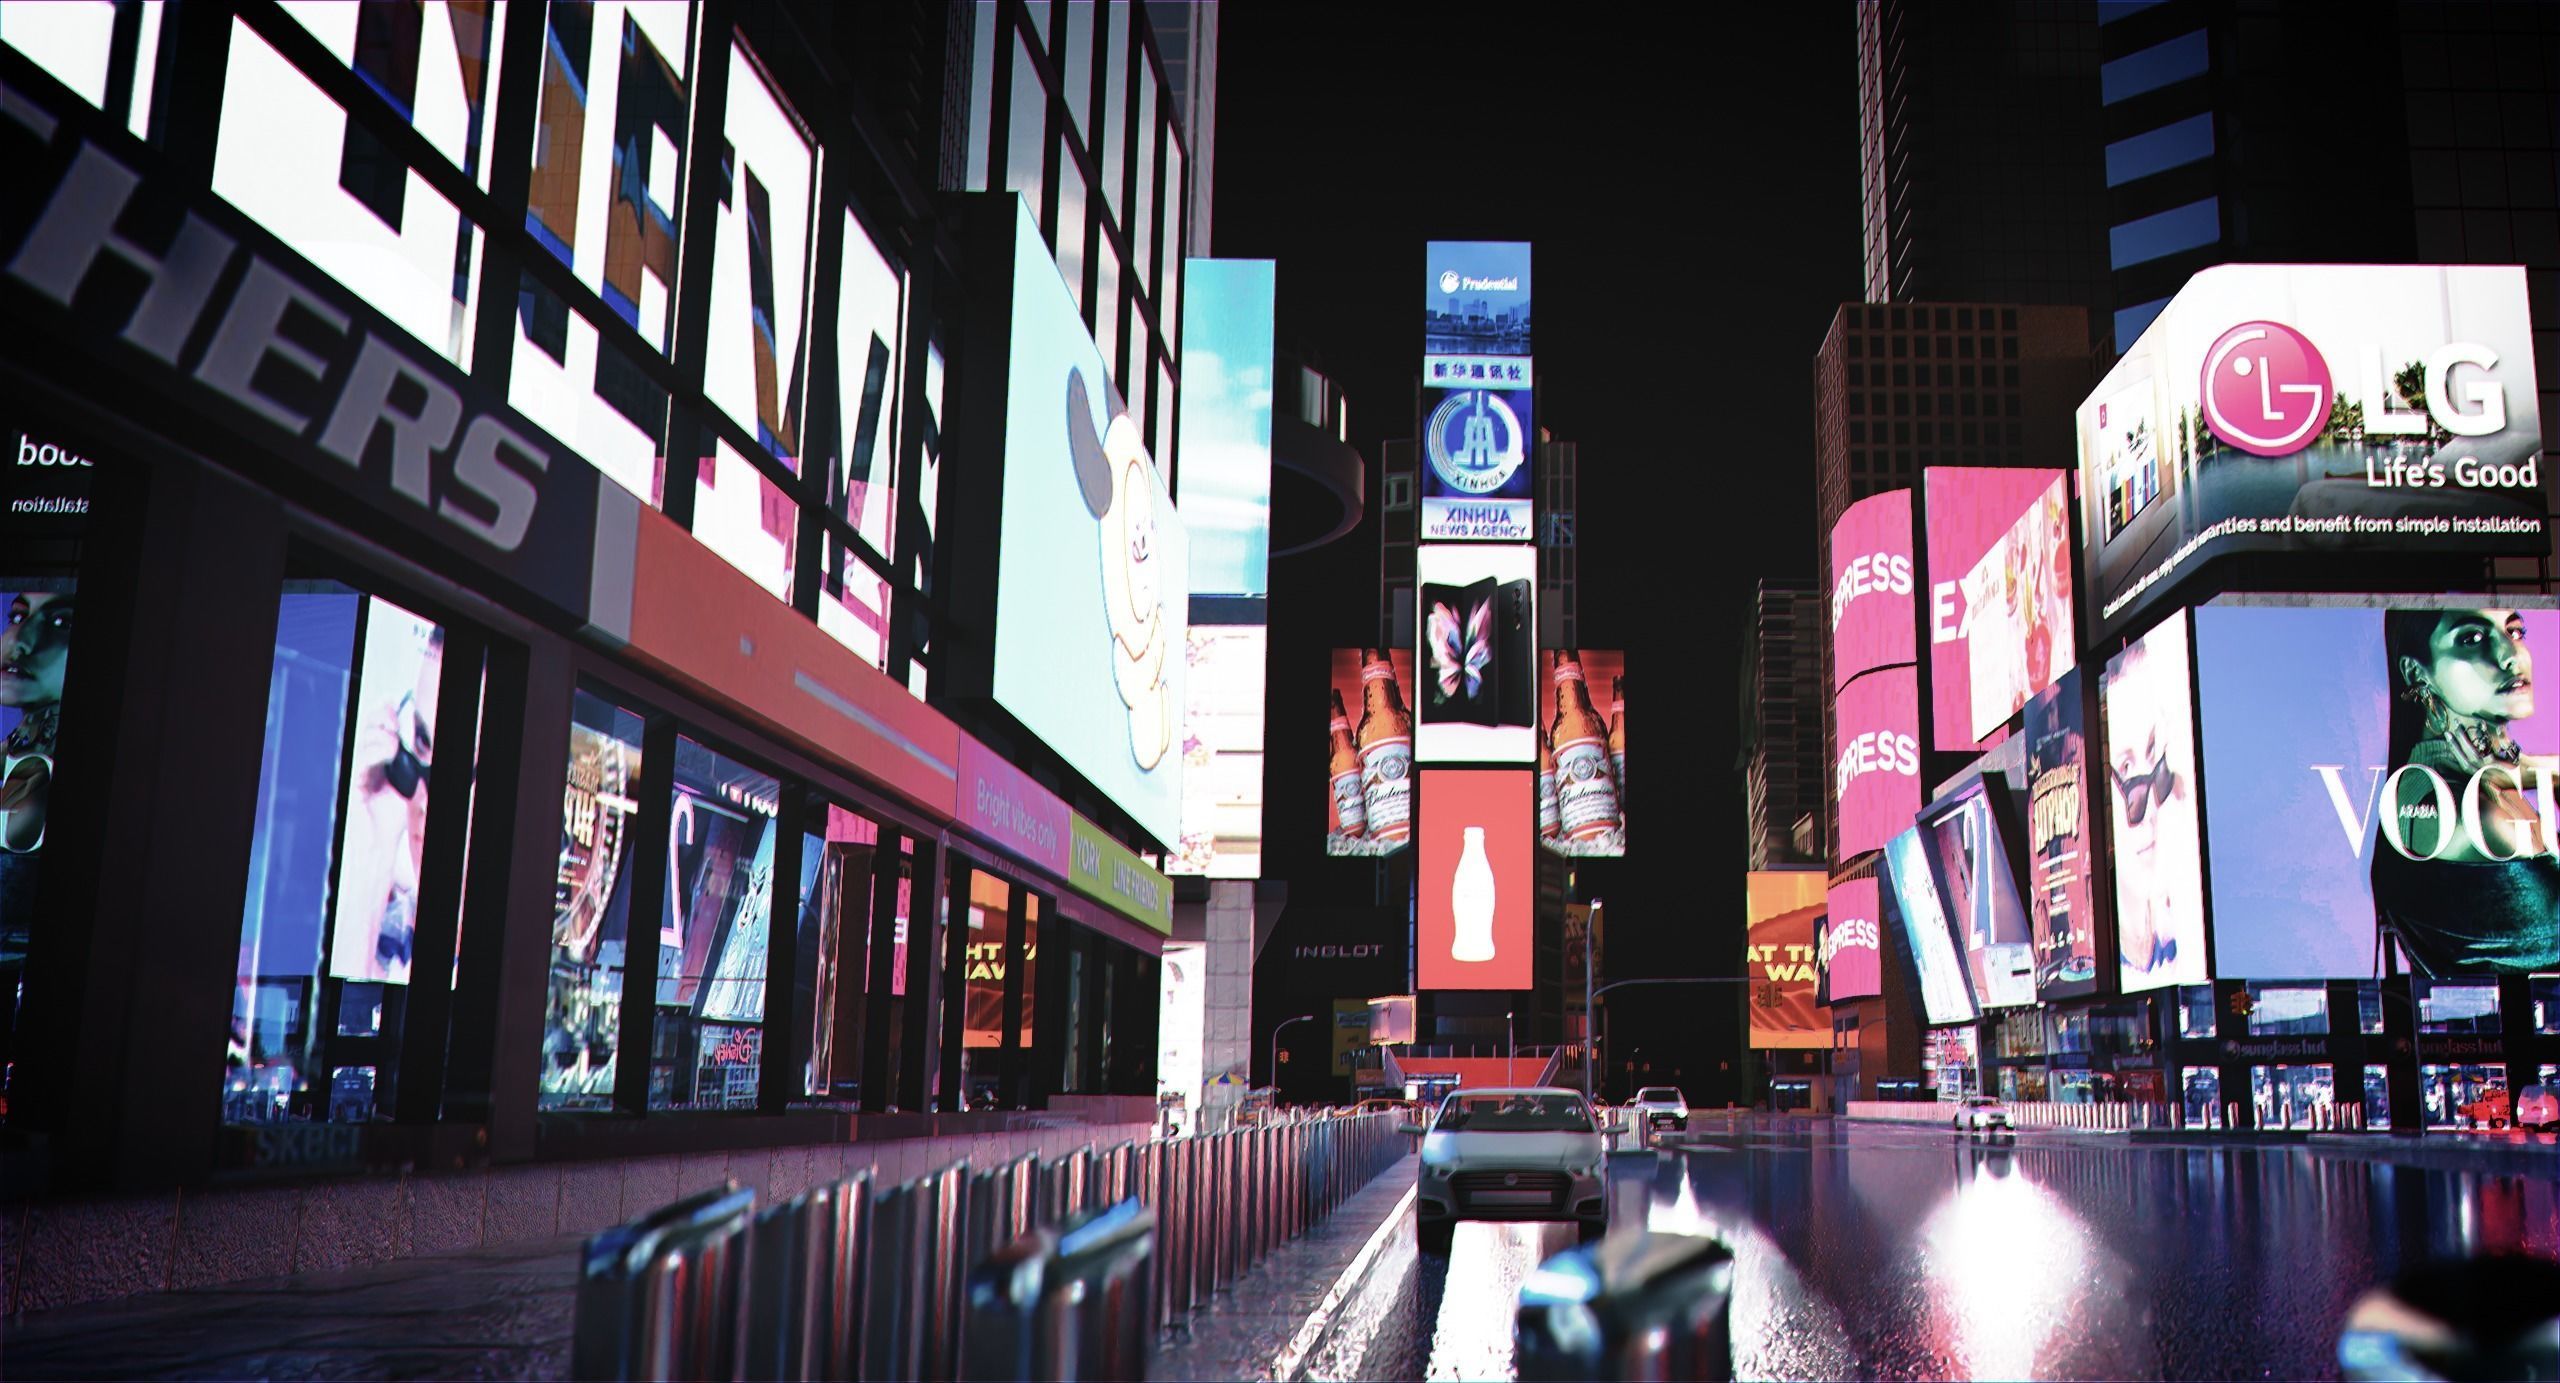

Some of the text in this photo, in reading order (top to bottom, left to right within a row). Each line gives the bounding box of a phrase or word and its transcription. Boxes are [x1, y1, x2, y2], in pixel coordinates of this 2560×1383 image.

[1461, 276, 1518, 291] Prudential
[0, 88, 552, 553] HERS
[2358, 343, 2507, 437] LG
[2365, 455, 2538, 488] Life's Good
[1445, 506, 1512, 523] XINHUA
[2260, 515, 2292, 532] and
[2294, 514, 2352, 533] benefit
[2354, 514, 2393, 533] from
[2395, 515, 2450, 536] simple
[2453, 515, 2541, 533] installation
[1430, 523, 1527, 538] NEWS AGENCY
[976, 775, 1058, 860] Bright vibes only
[1075, 831, 1101, 880] YORK
[1112, 855, 1130, 898] LINE
[1130, 866, 1159, 913] FRIENDS
[1295, 944, 1384, 959] INGLOT
[2302, 1038, 2328, 1056] hut
